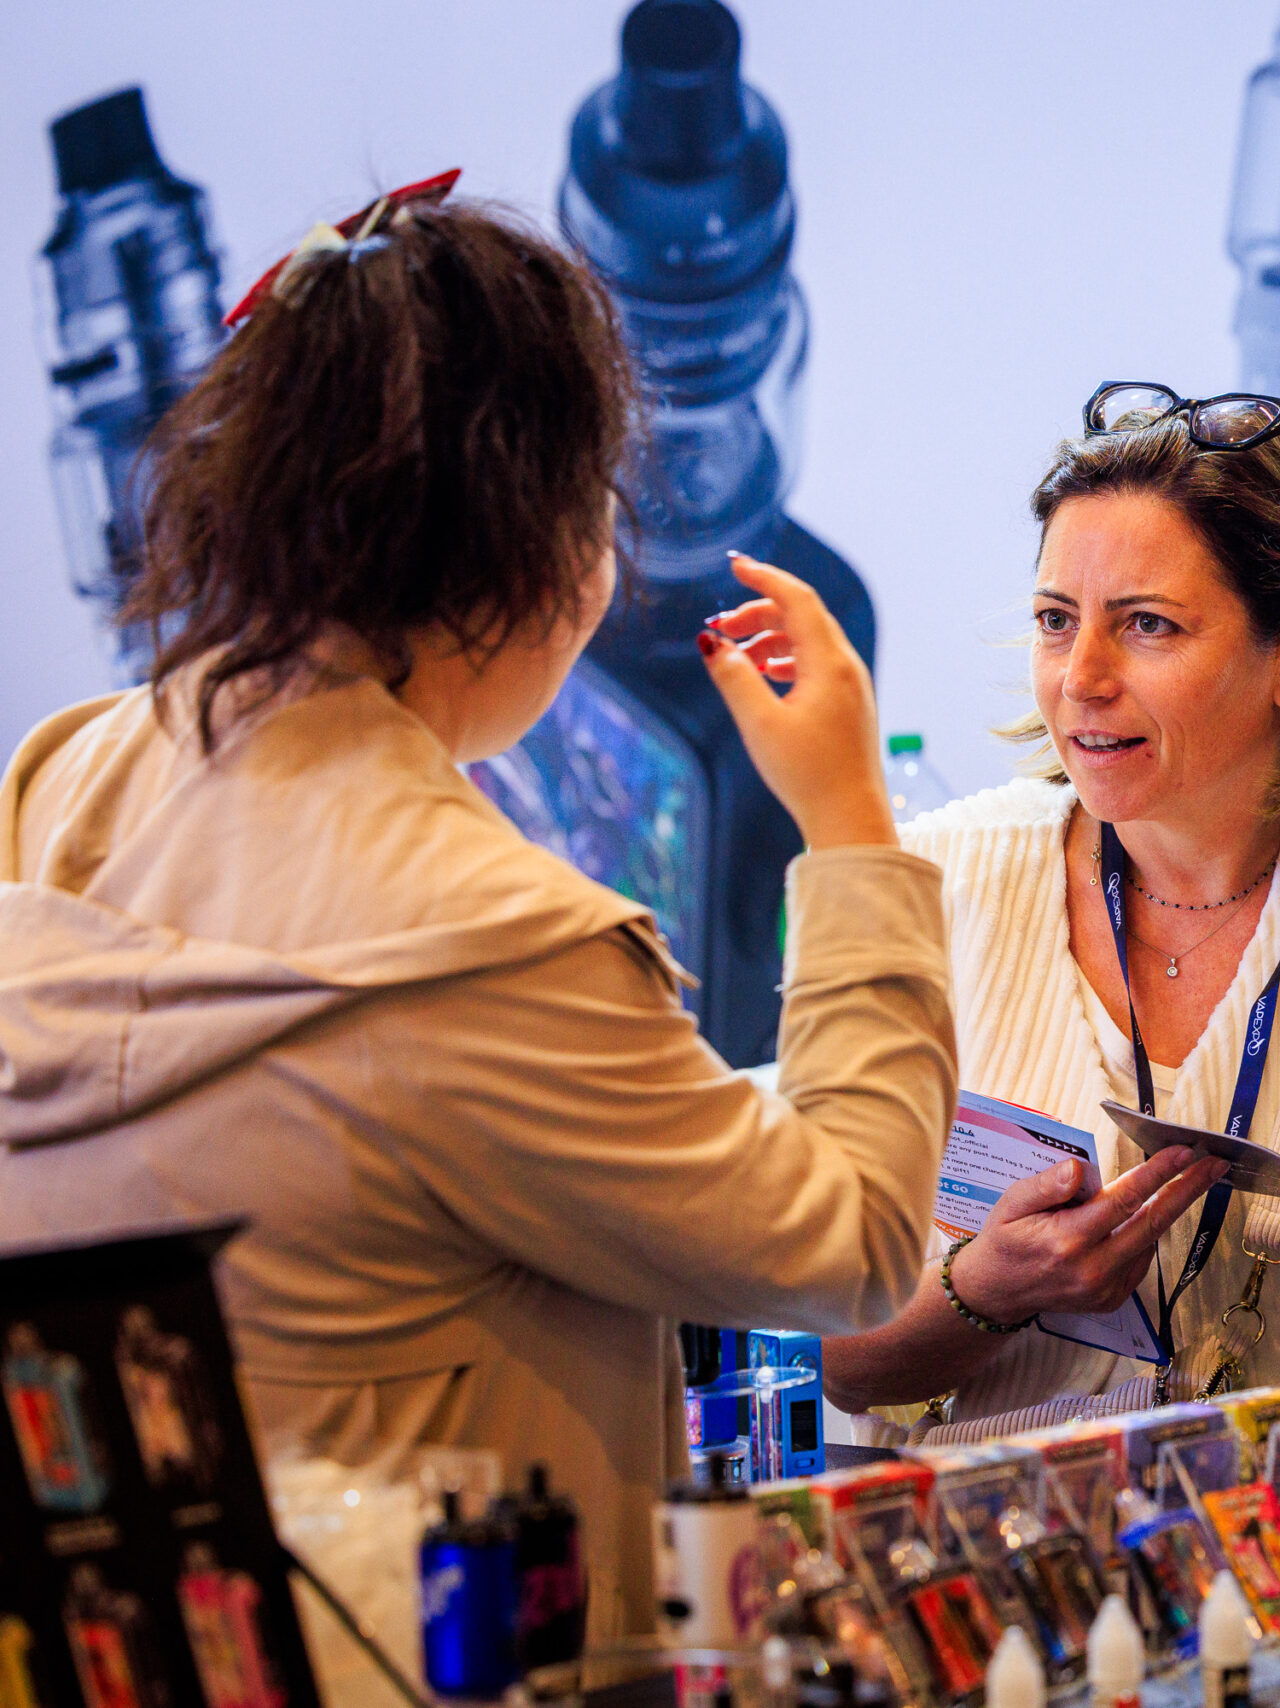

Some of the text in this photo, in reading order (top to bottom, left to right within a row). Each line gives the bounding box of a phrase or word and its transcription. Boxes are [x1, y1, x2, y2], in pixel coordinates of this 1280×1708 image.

[1247, 995, 1267, 1056] VAPEXPO
[1031, 1151, 1057, 1165] 14:00
[951, 1183, 969, 1194] GO
